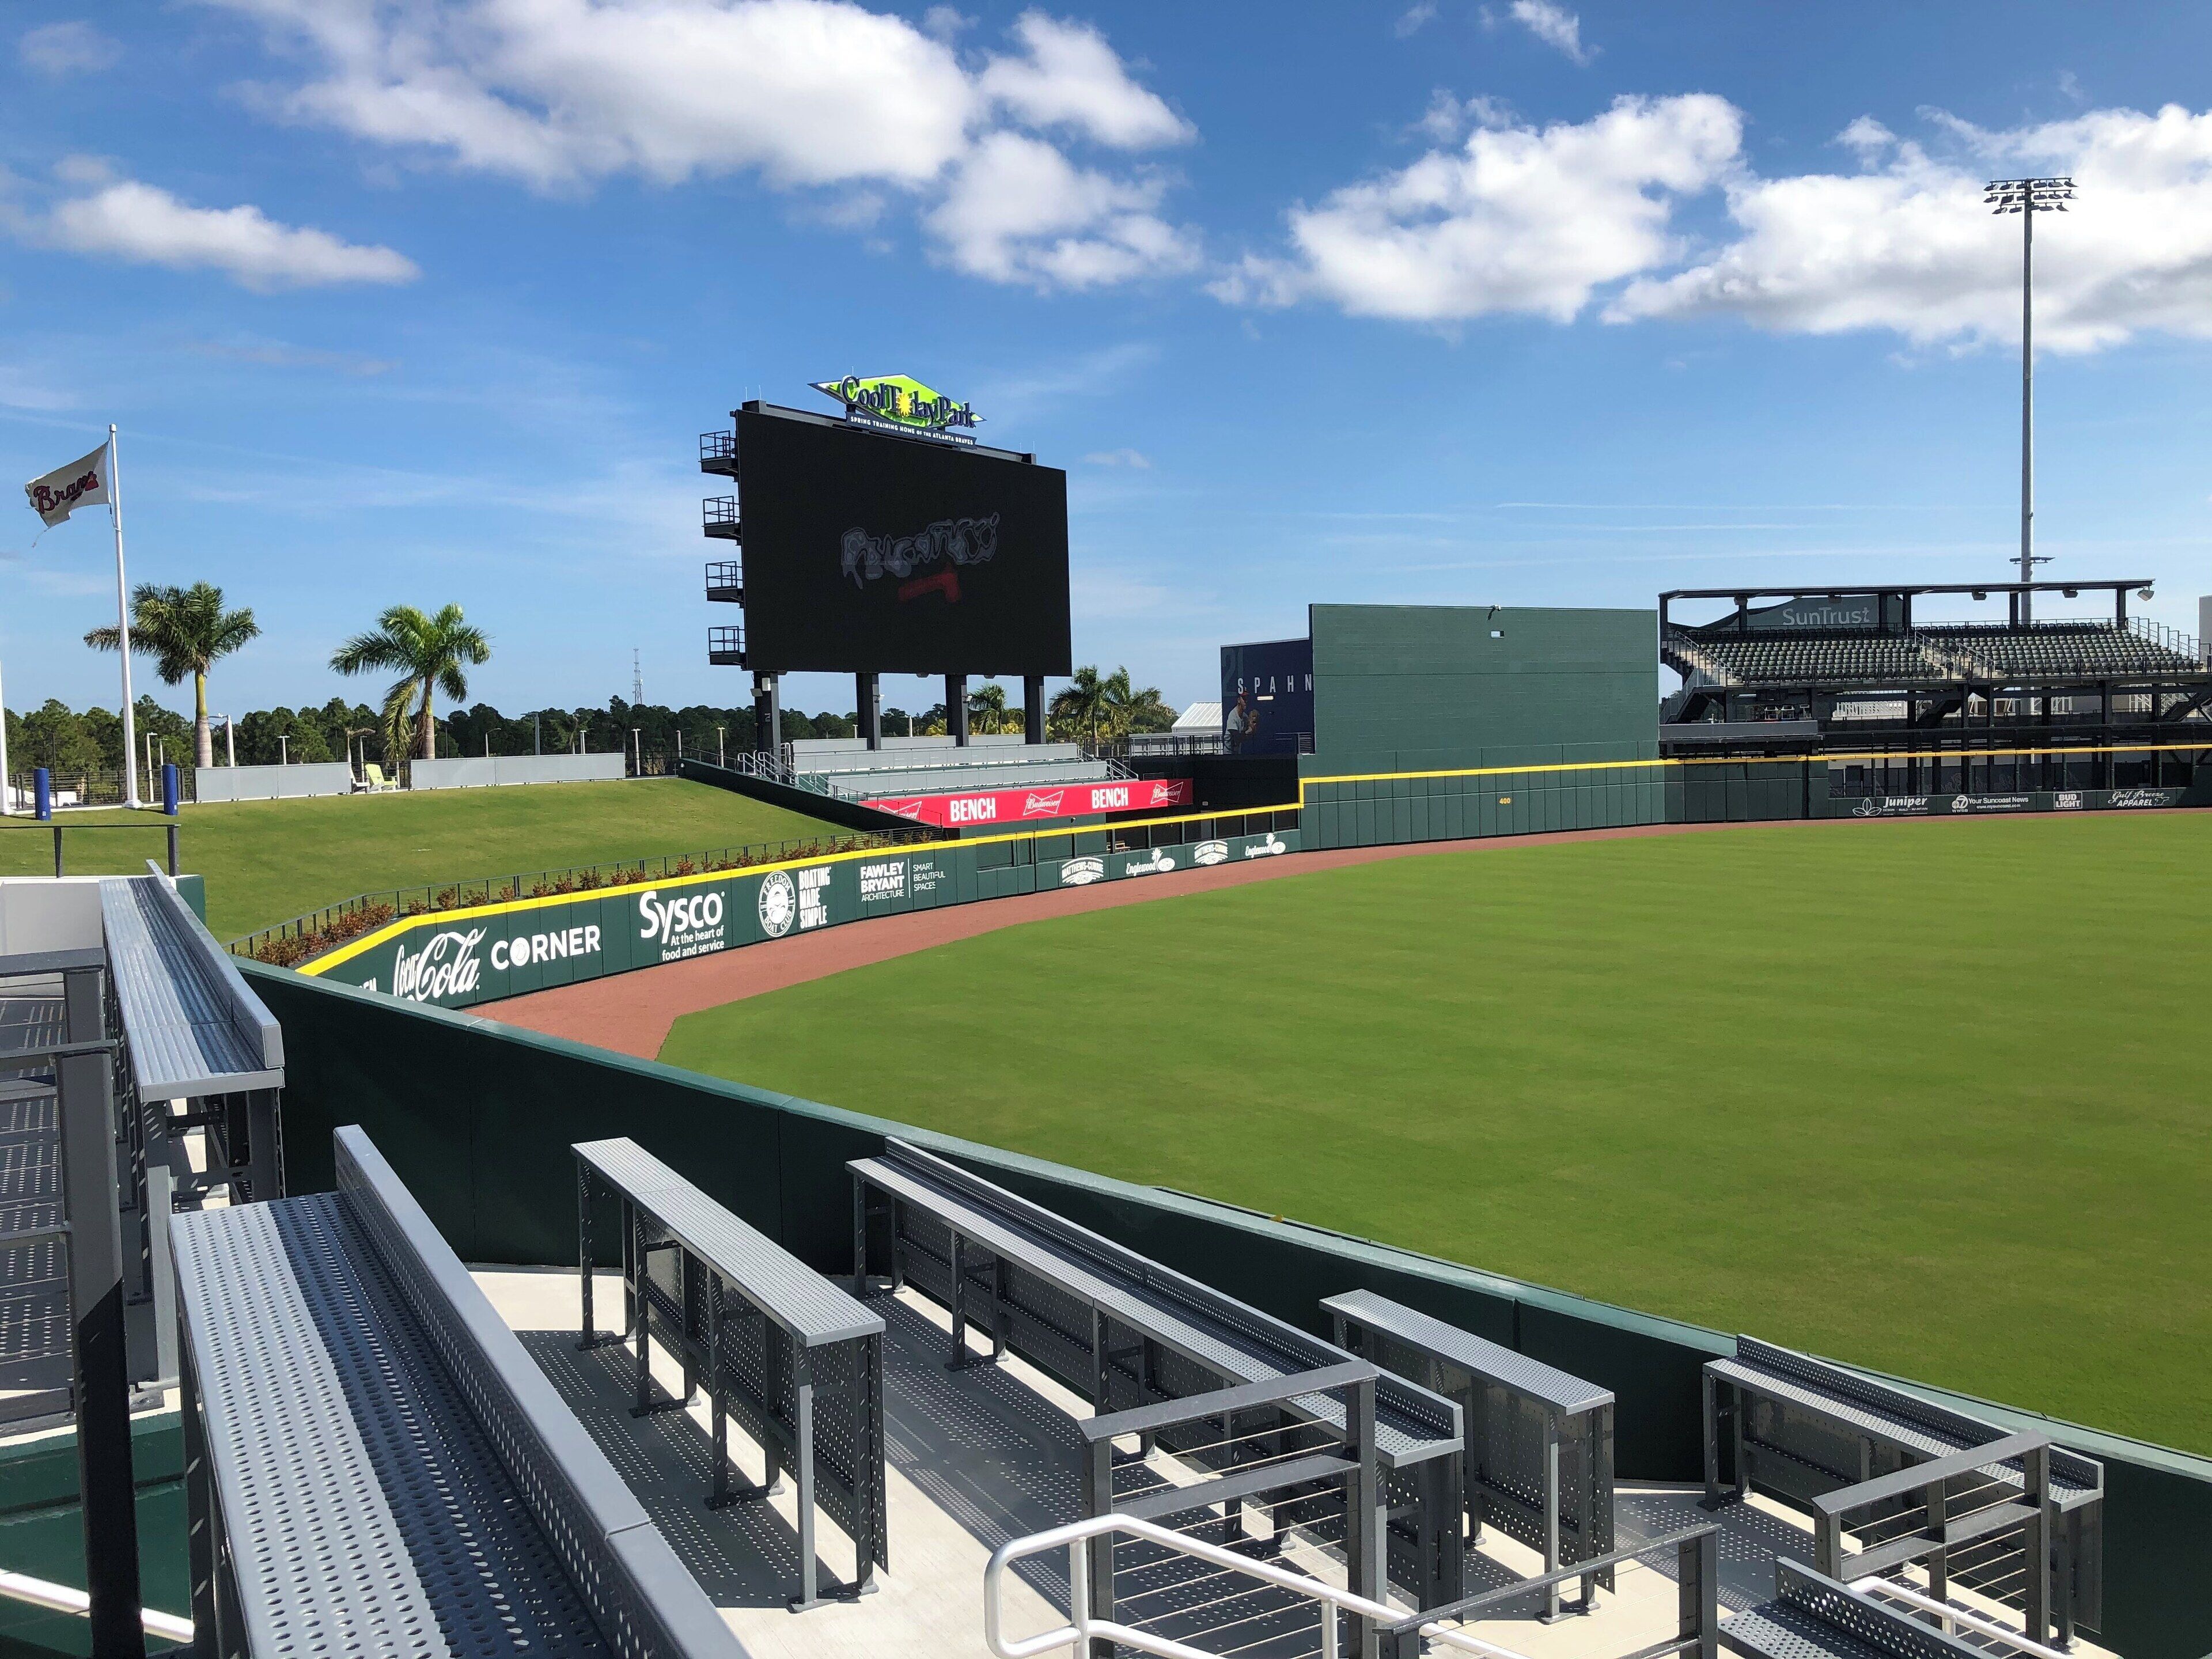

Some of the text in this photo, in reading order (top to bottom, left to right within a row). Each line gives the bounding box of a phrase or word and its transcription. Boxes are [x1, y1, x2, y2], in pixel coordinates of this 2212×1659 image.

[850, 416, 871, 426] SPRING
[873, 421, 898, 431] TRAINING
[900, 426, 915, 434] HOME
[933, 433, 954, 442] ATLANTA
[955, 437, 974, 445] BRAVES
[1782, 607, 1870, 626] SunTrust
[1237, 673, 1312, 695] SPAHN
[1026, 798, 1061, 809] Budweiser
[1090, 787, 1129, 809] BENCH
[1883, 796, 1928, 808] Juniper
[2107, 790, 2131, 804] Gulf
[950, 797, 997, 822] BENCH
[860, 862, 904, 880] FAWLEY
[913, 862, 934, 872] SMART
[913, 871, 946, 882] BEAUTIFUL
[1126, 861, 1157, 877] Englewood
[763, 874, 791, 896] FREEDOM
[798, 866, 831, 891] BOATING
[861, 875, 905, 893] BRYANT
[914, 881, 936, 892] SPACES
[799, 887, 821, 910] MADE
[861, 889, 904, 903] ARCHITECTURE
[764, 910, 793, 933] BOAT CLUB
[800, 905, 828, 929] SIMPLE
[671, 925, 724, 946] At the heart of
[491, 925, 601, 970] CORNER
[662, 940, 725, 961] food and service
